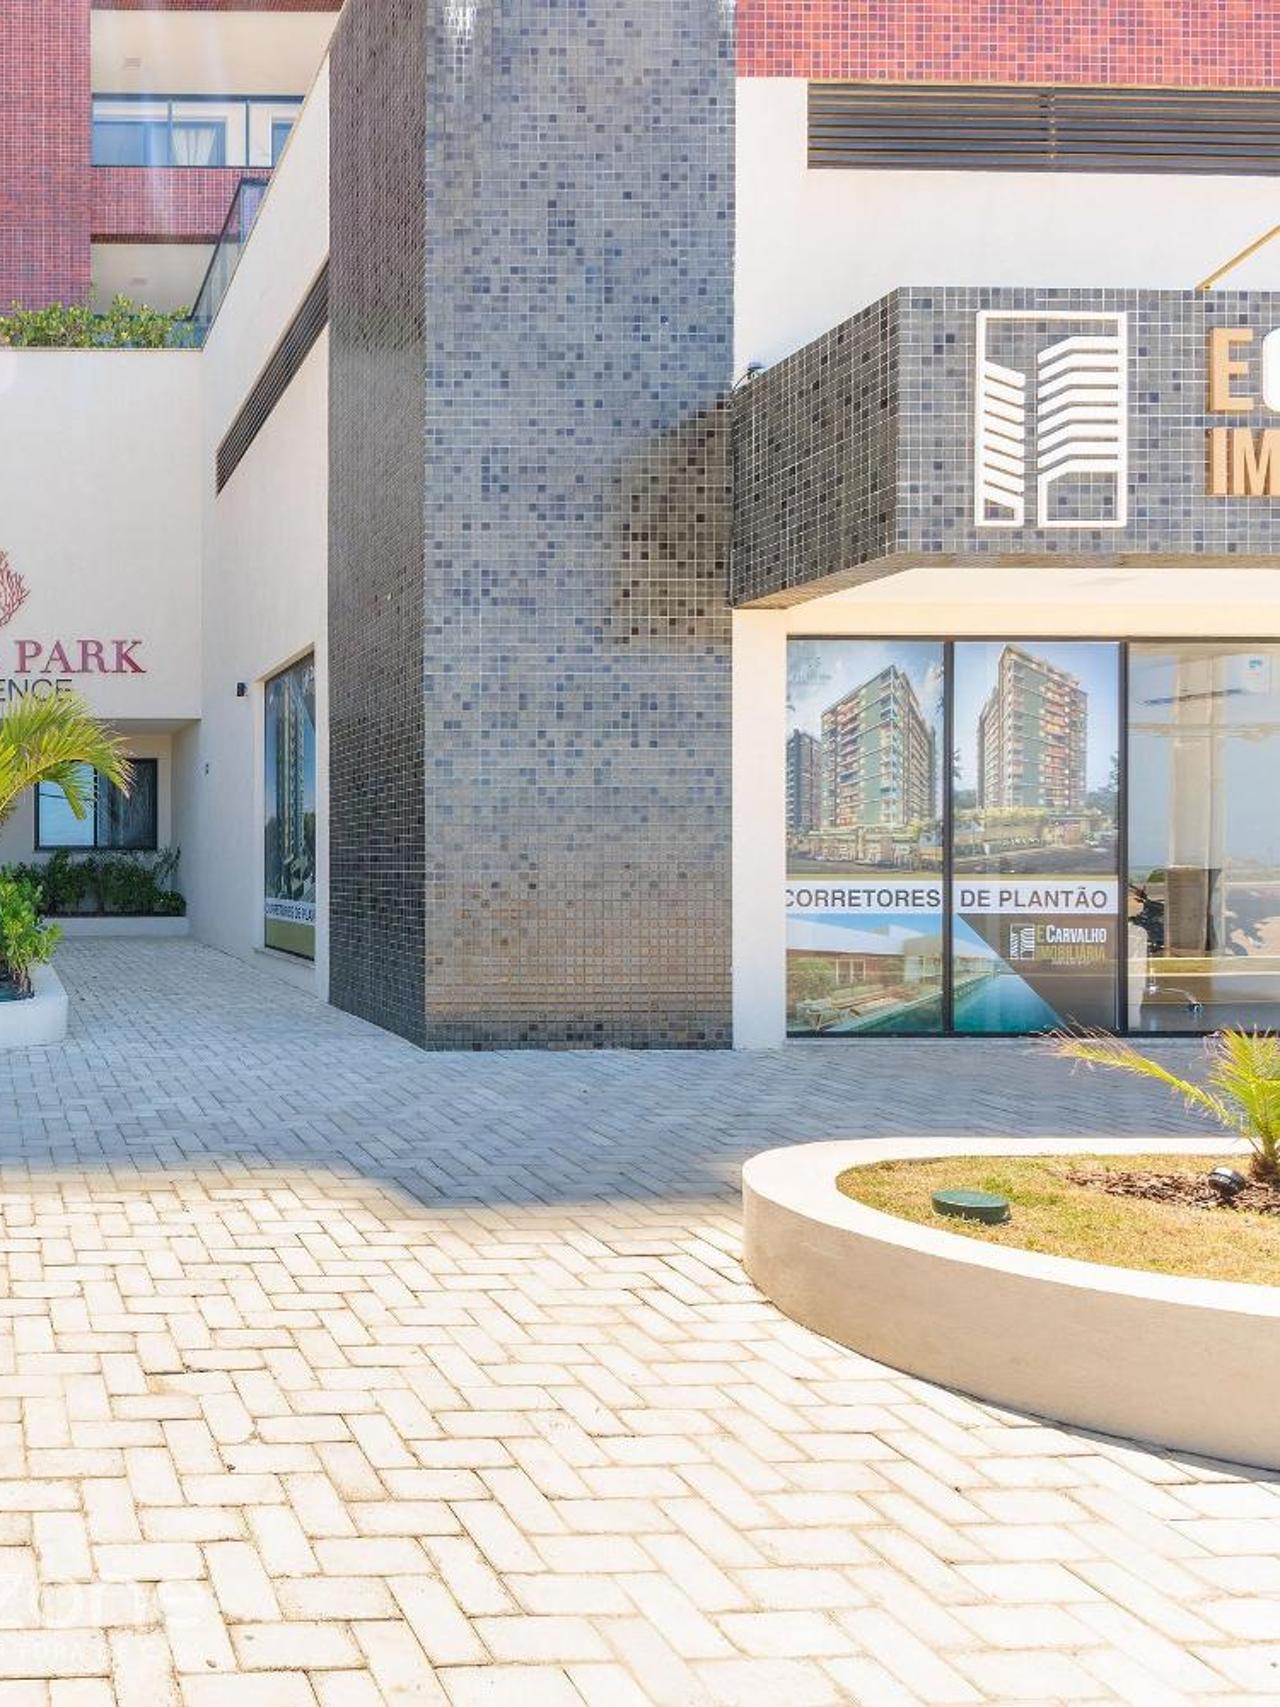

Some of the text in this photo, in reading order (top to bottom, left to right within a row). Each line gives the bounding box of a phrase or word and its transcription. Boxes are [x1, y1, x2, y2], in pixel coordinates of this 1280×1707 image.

[14, 640, 147, 673] PARK
[785, 887, 1108, 908] CORRETORES DE PLANTÃO
